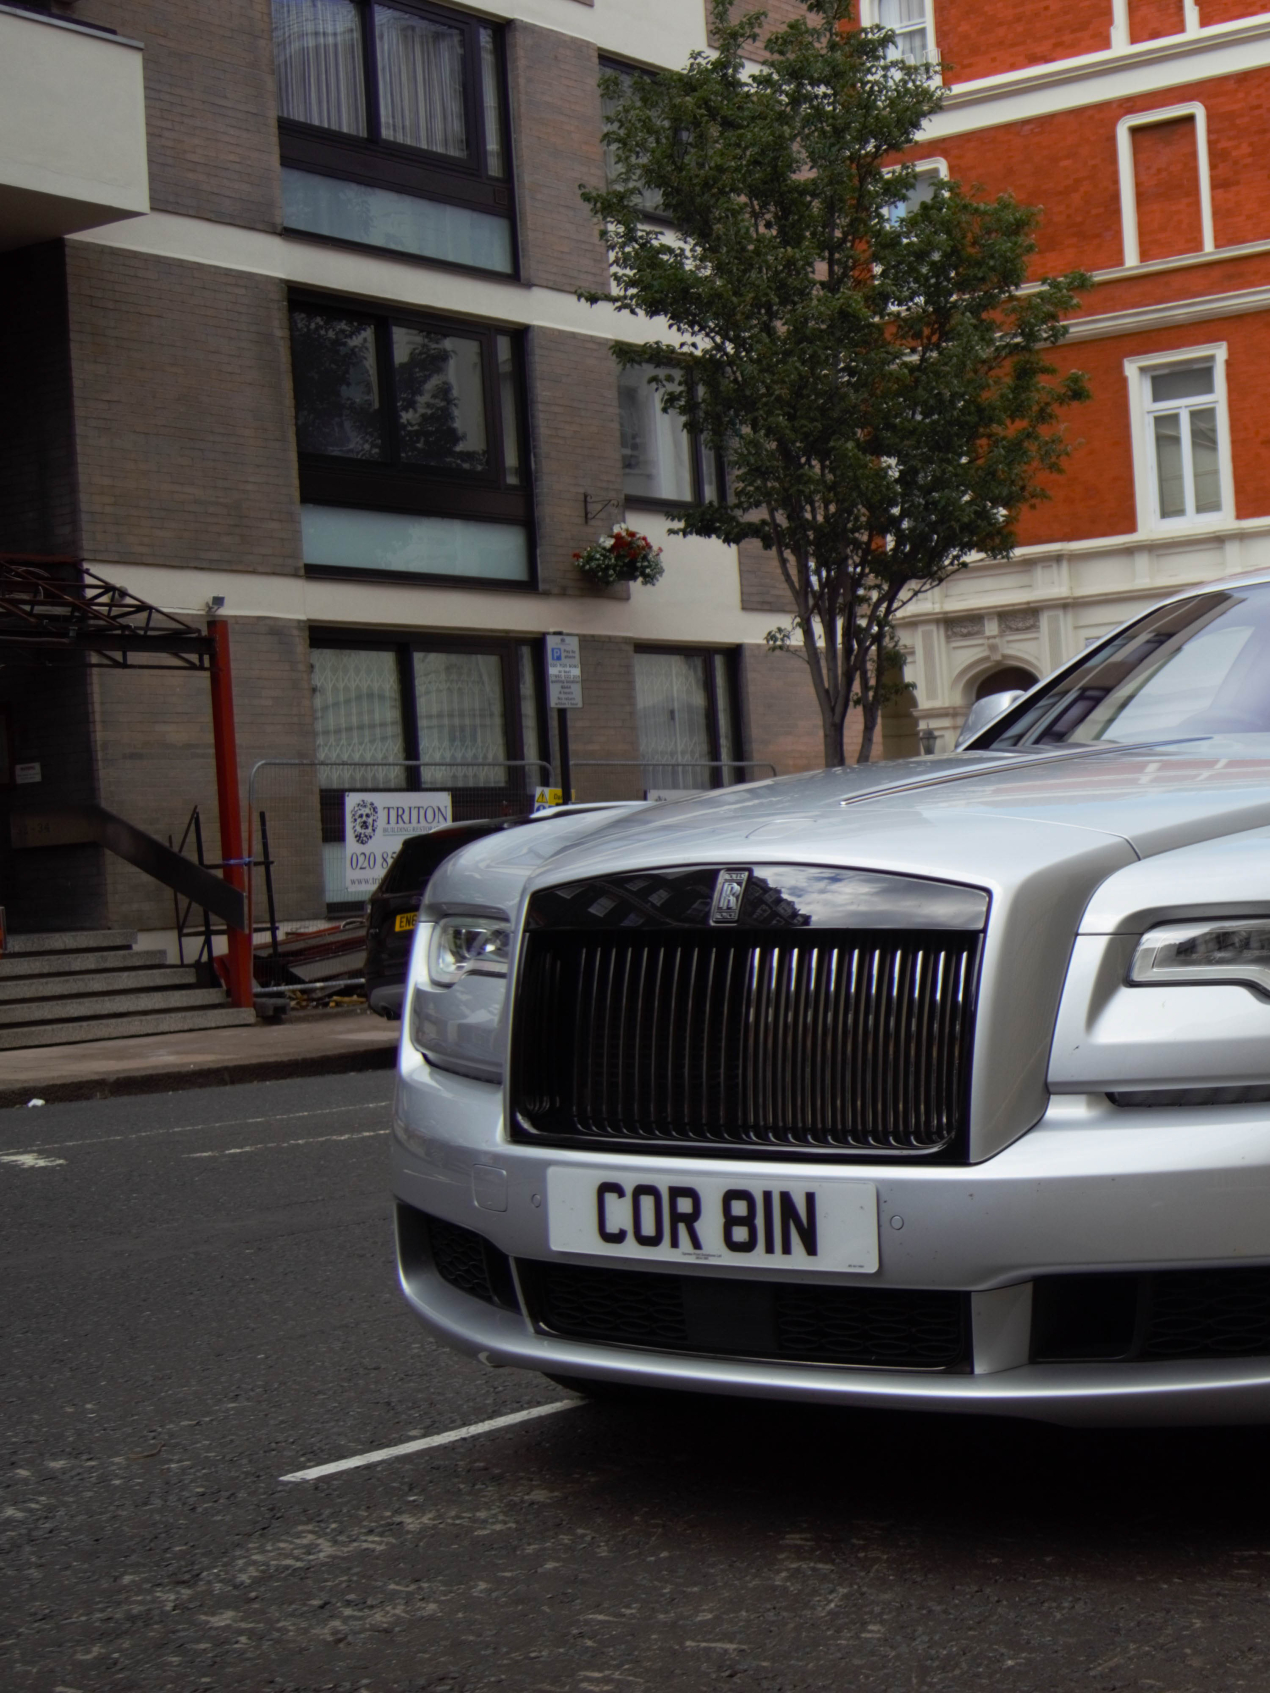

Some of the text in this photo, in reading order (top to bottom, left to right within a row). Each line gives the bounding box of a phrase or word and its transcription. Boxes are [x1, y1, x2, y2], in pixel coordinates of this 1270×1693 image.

[553, 649, 560, 660] P
[383, 805, 448, 825] TRITON
[382, 825, 439, 834] BUILDING RESTOR
[350, 852, 376, 871] 020
[350, 873, 383, 886] www.tri
[596, 1181, 703, 1250] COR
